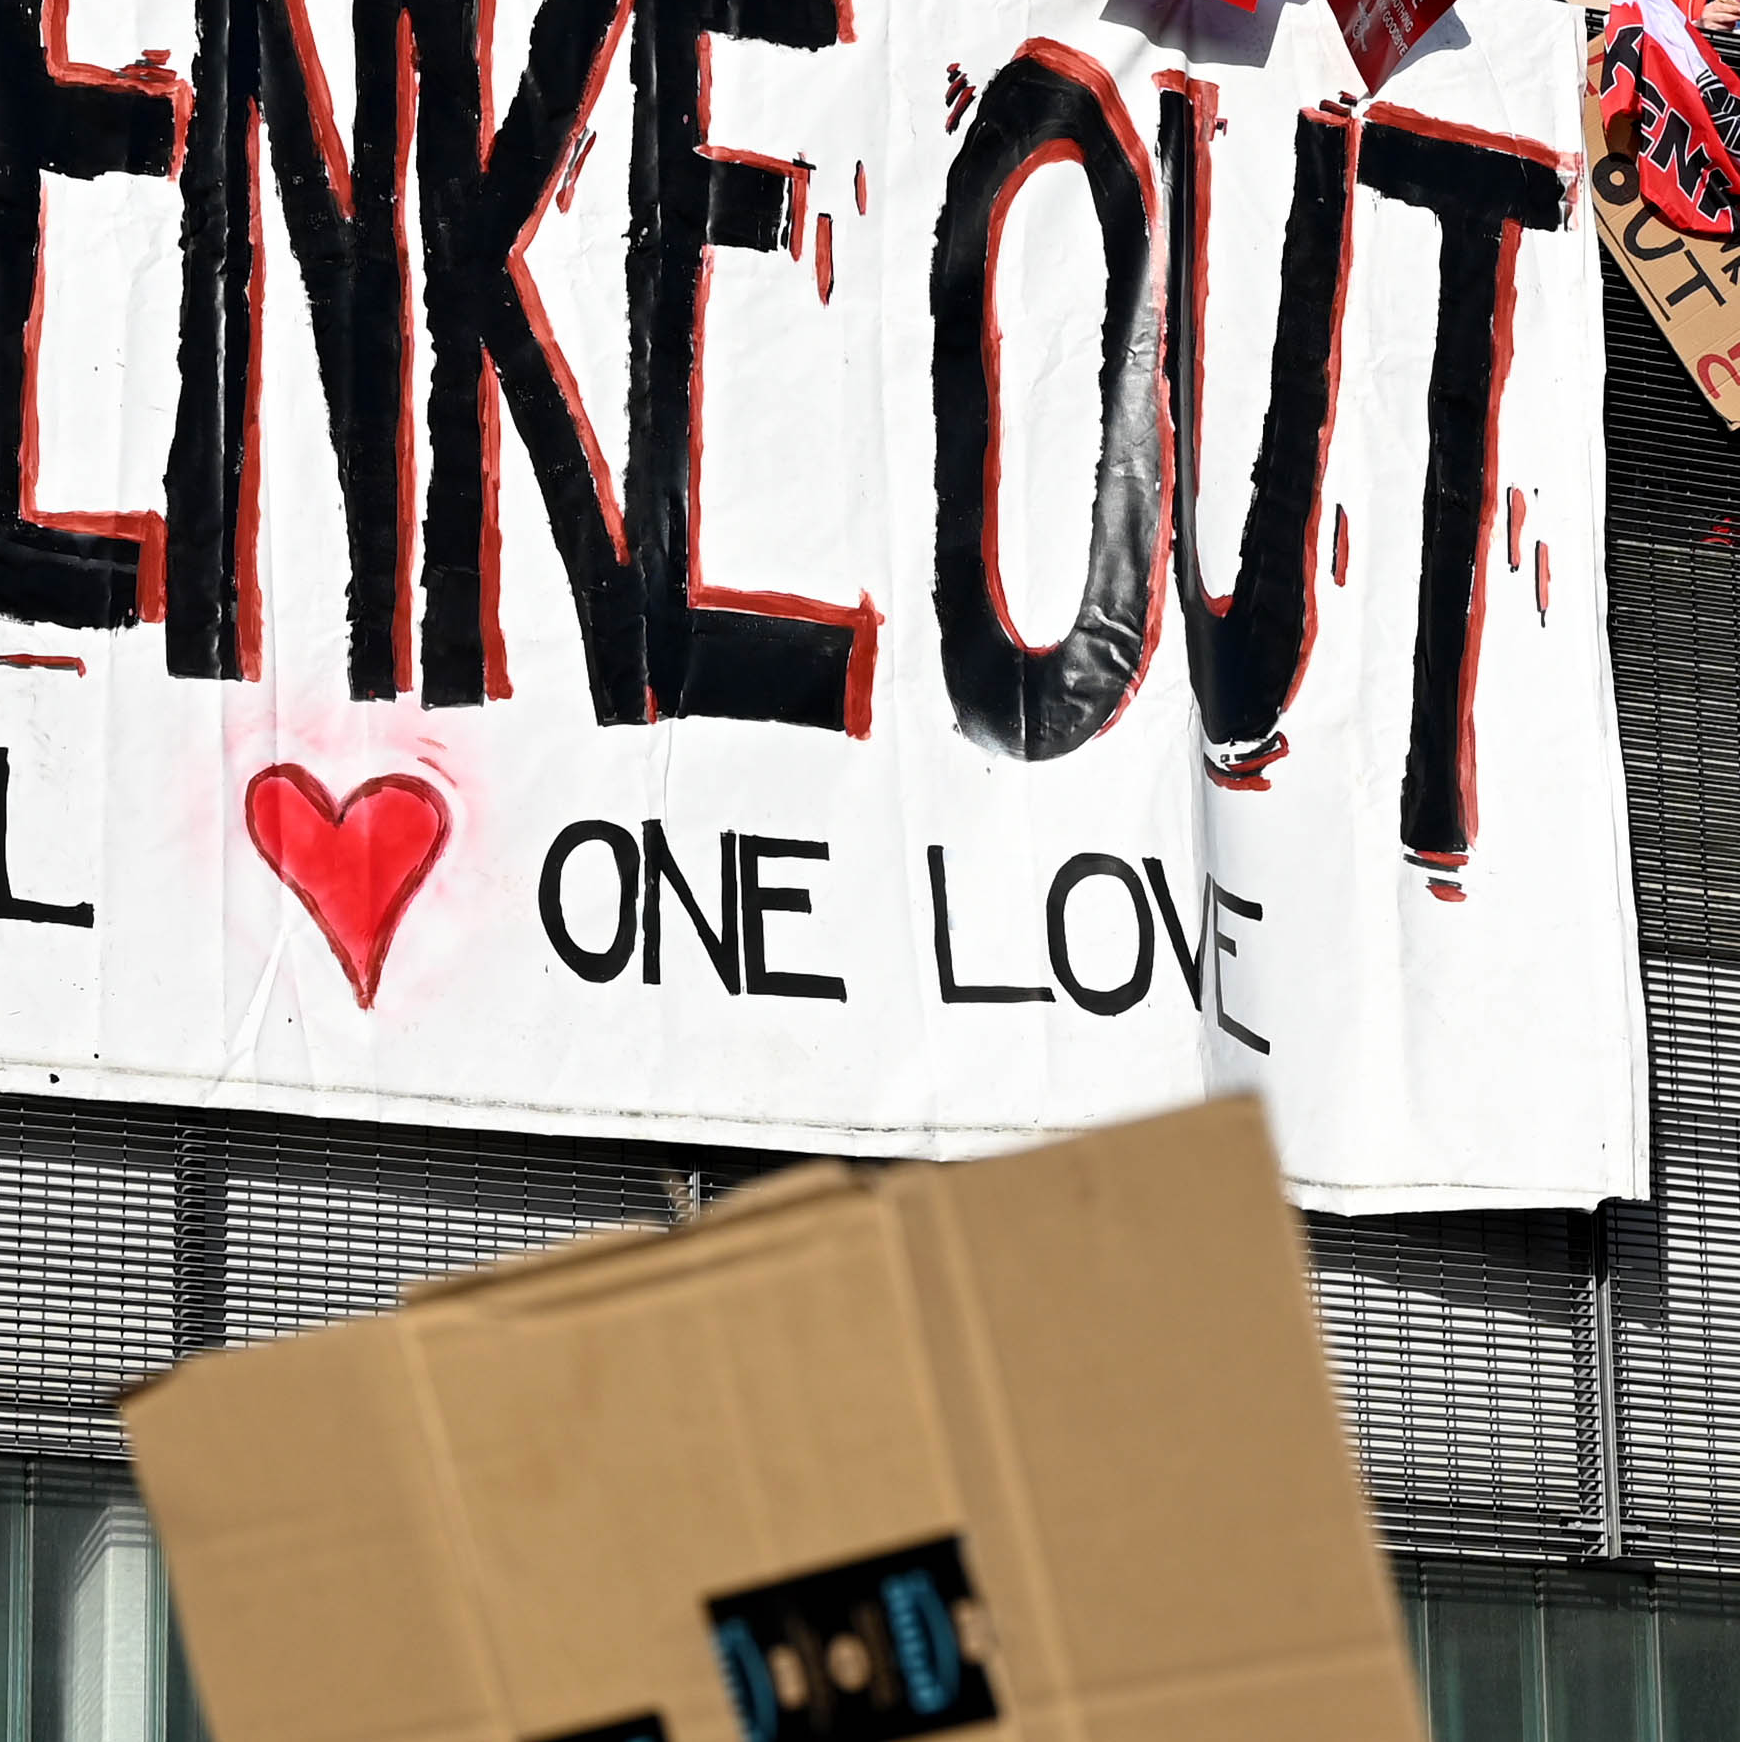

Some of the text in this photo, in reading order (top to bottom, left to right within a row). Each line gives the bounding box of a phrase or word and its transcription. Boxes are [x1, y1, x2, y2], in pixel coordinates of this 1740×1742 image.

[1592, 152, 1727, 307] OUT
[932, 36, 1575, 869] OUT
[538, 816, 844, 1004] ONE
[930, 846, 1270, 1055] LOVE
